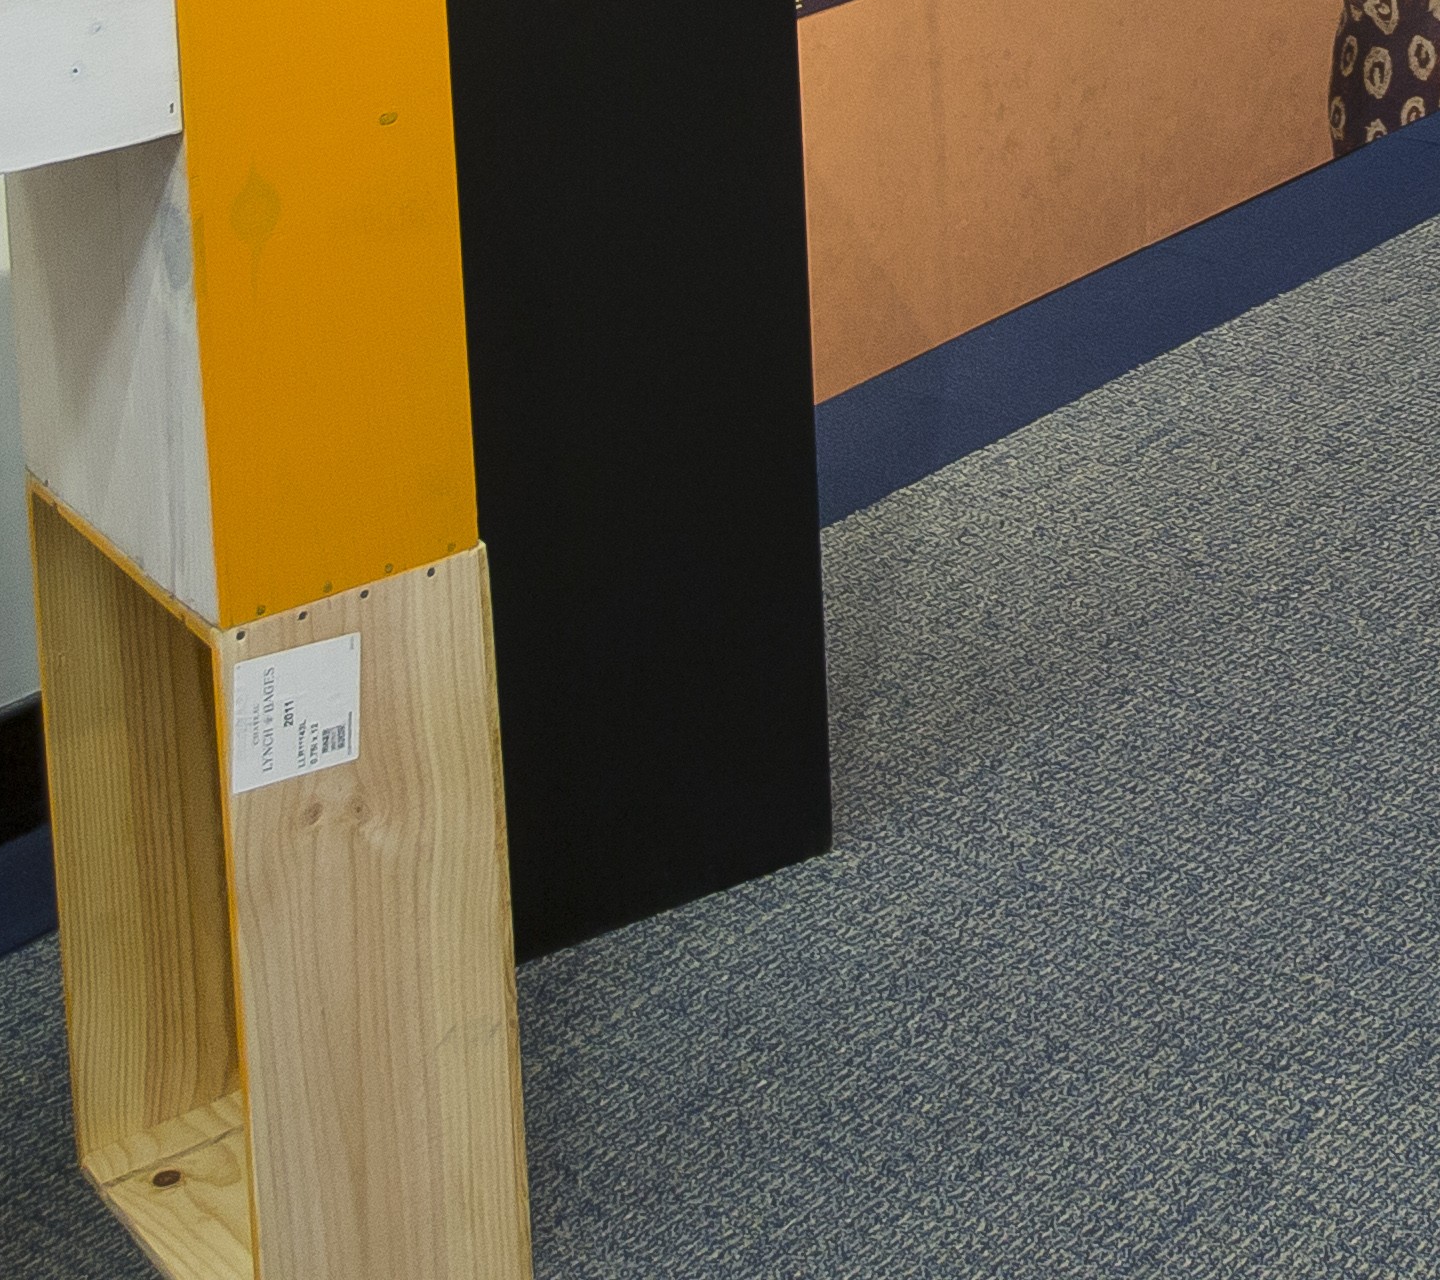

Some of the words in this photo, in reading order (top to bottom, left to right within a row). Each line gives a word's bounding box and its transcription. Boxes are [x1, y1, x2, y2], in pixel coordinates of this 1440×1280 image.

[263, 666, 275, 714] BAGES
[283, 700, 295, 728] 2011
[262, 727, 274, 773] LYNCH
